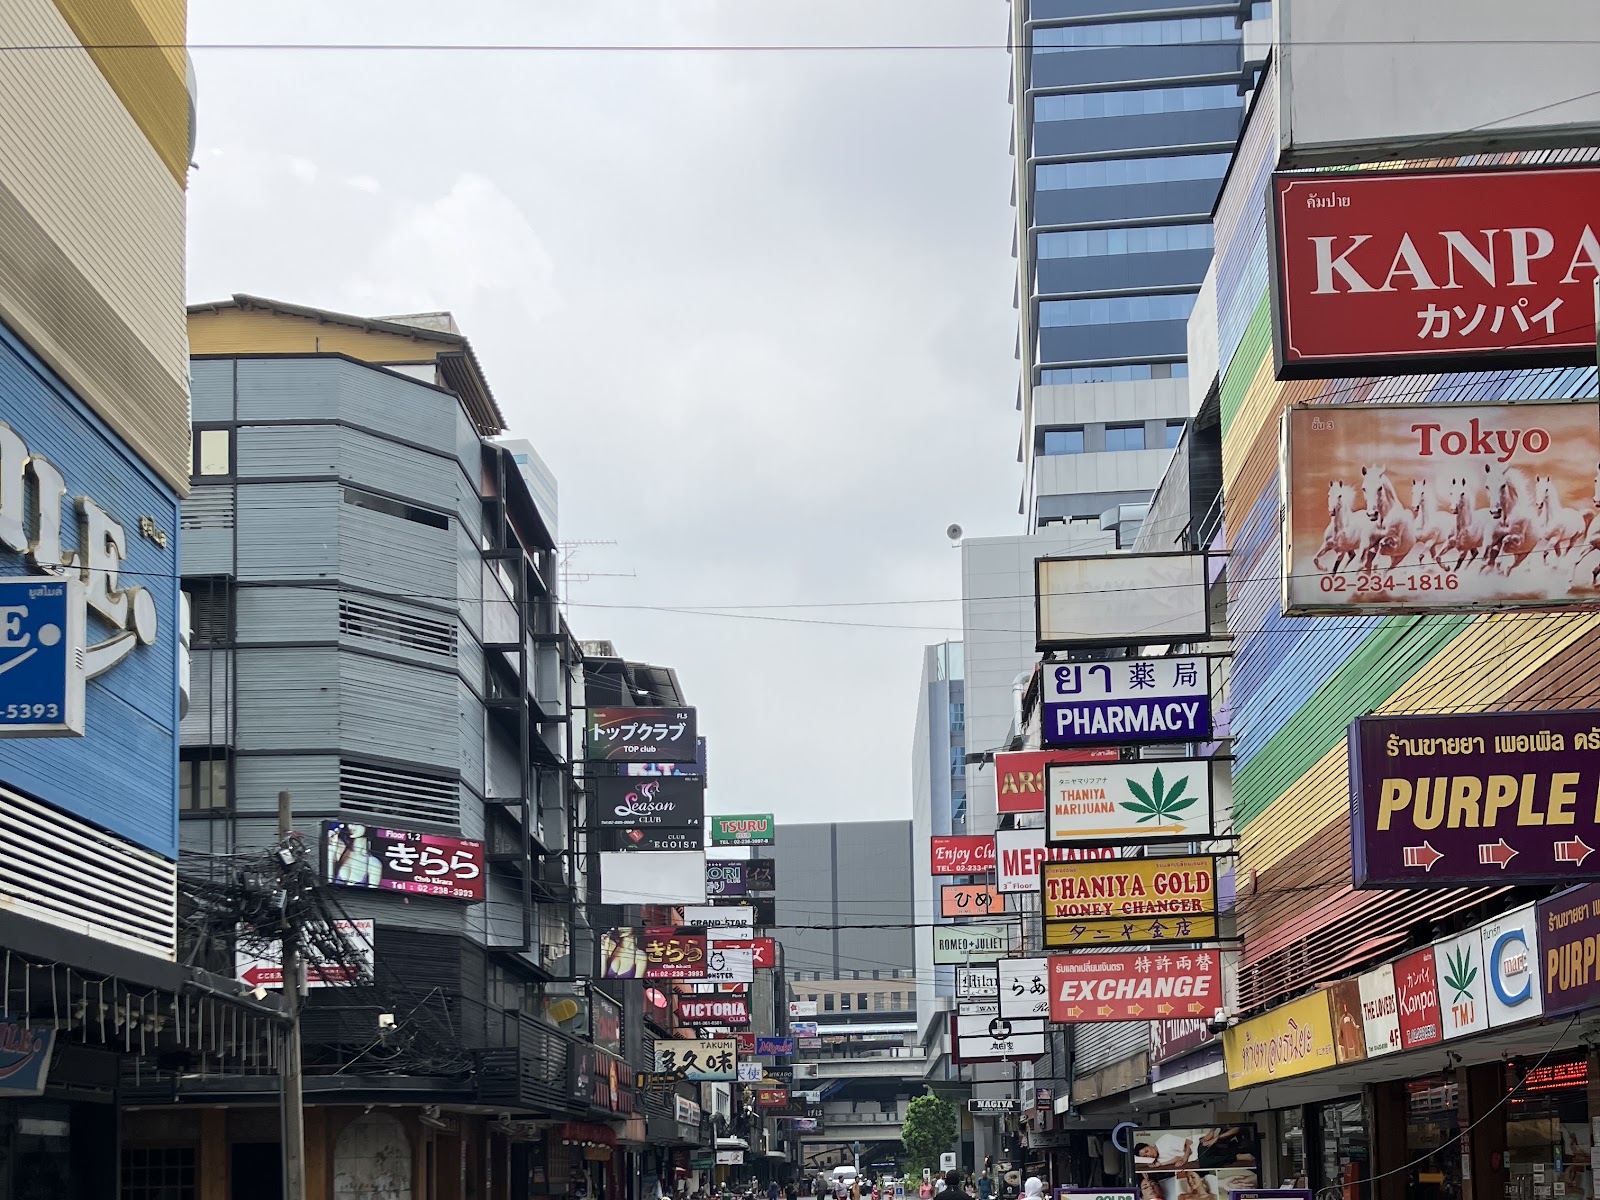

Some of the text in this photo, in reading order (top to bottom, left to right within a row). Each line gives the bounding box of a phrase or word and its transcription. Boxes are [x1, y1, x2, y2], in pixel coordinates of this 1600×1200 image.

[1326, 421, 1334, 430] 3
[1411, 417, 1551, 462] Tokyo
[1320, 574, 1459, 592] 02-234-1816
[1054, 664, 1112, 694] ยา
[1129, 662, 1198, 690] 薬局
[1056, 702, 1200, 736] PHARMACY
[594, 722, 687, 741] トップクラブ
[624, 745, 656, 753] TOP club
[1386, 733, 1484, 757] ร้านขายยา
[614, 792, 676, 816] Season
[1060, 789, 1106, 801] THANIYA
[1376, 772, 1581, 831] PURPLE
[1055, 802, 1115, 815] MARIJUANA
[385, 830, 405, 840] Floor
[720, 819, 768, 833] TSURU
[384, 843, 480, 879] きらら
[936, 846, 971, 864] Enjoy
[1046, 871, 1211, 900] THANIYA GOLD
[954, 892, 992, 908] ひめ
[1056, 899, 1203, 917] MONEY CHANGER
[725, 919, 747, 927] STAR
[1548, 904, 1589, 932] ร้านขายยา
[1069, 918, 1193, 942] タニヤ金店
[645, 940, 703, 963] きらら
[1489, 925, 1533, 1007] C
[1059, 975, 1213, 1002] EXCHANGE
[1397, 979, 1437, 1021] Kanpai
[682, 1003, 746, 1017] VICTORIA
[1363, 994, 1396, 1021] THE LOVERS
[1451, 1001, 1475, 1028] TMJ
[1389, 1028, 1399, 1047] 4F
[662, 1050, 733, 1073] 多久味
[977, 1100, 1014, 1108] NAGIYA
